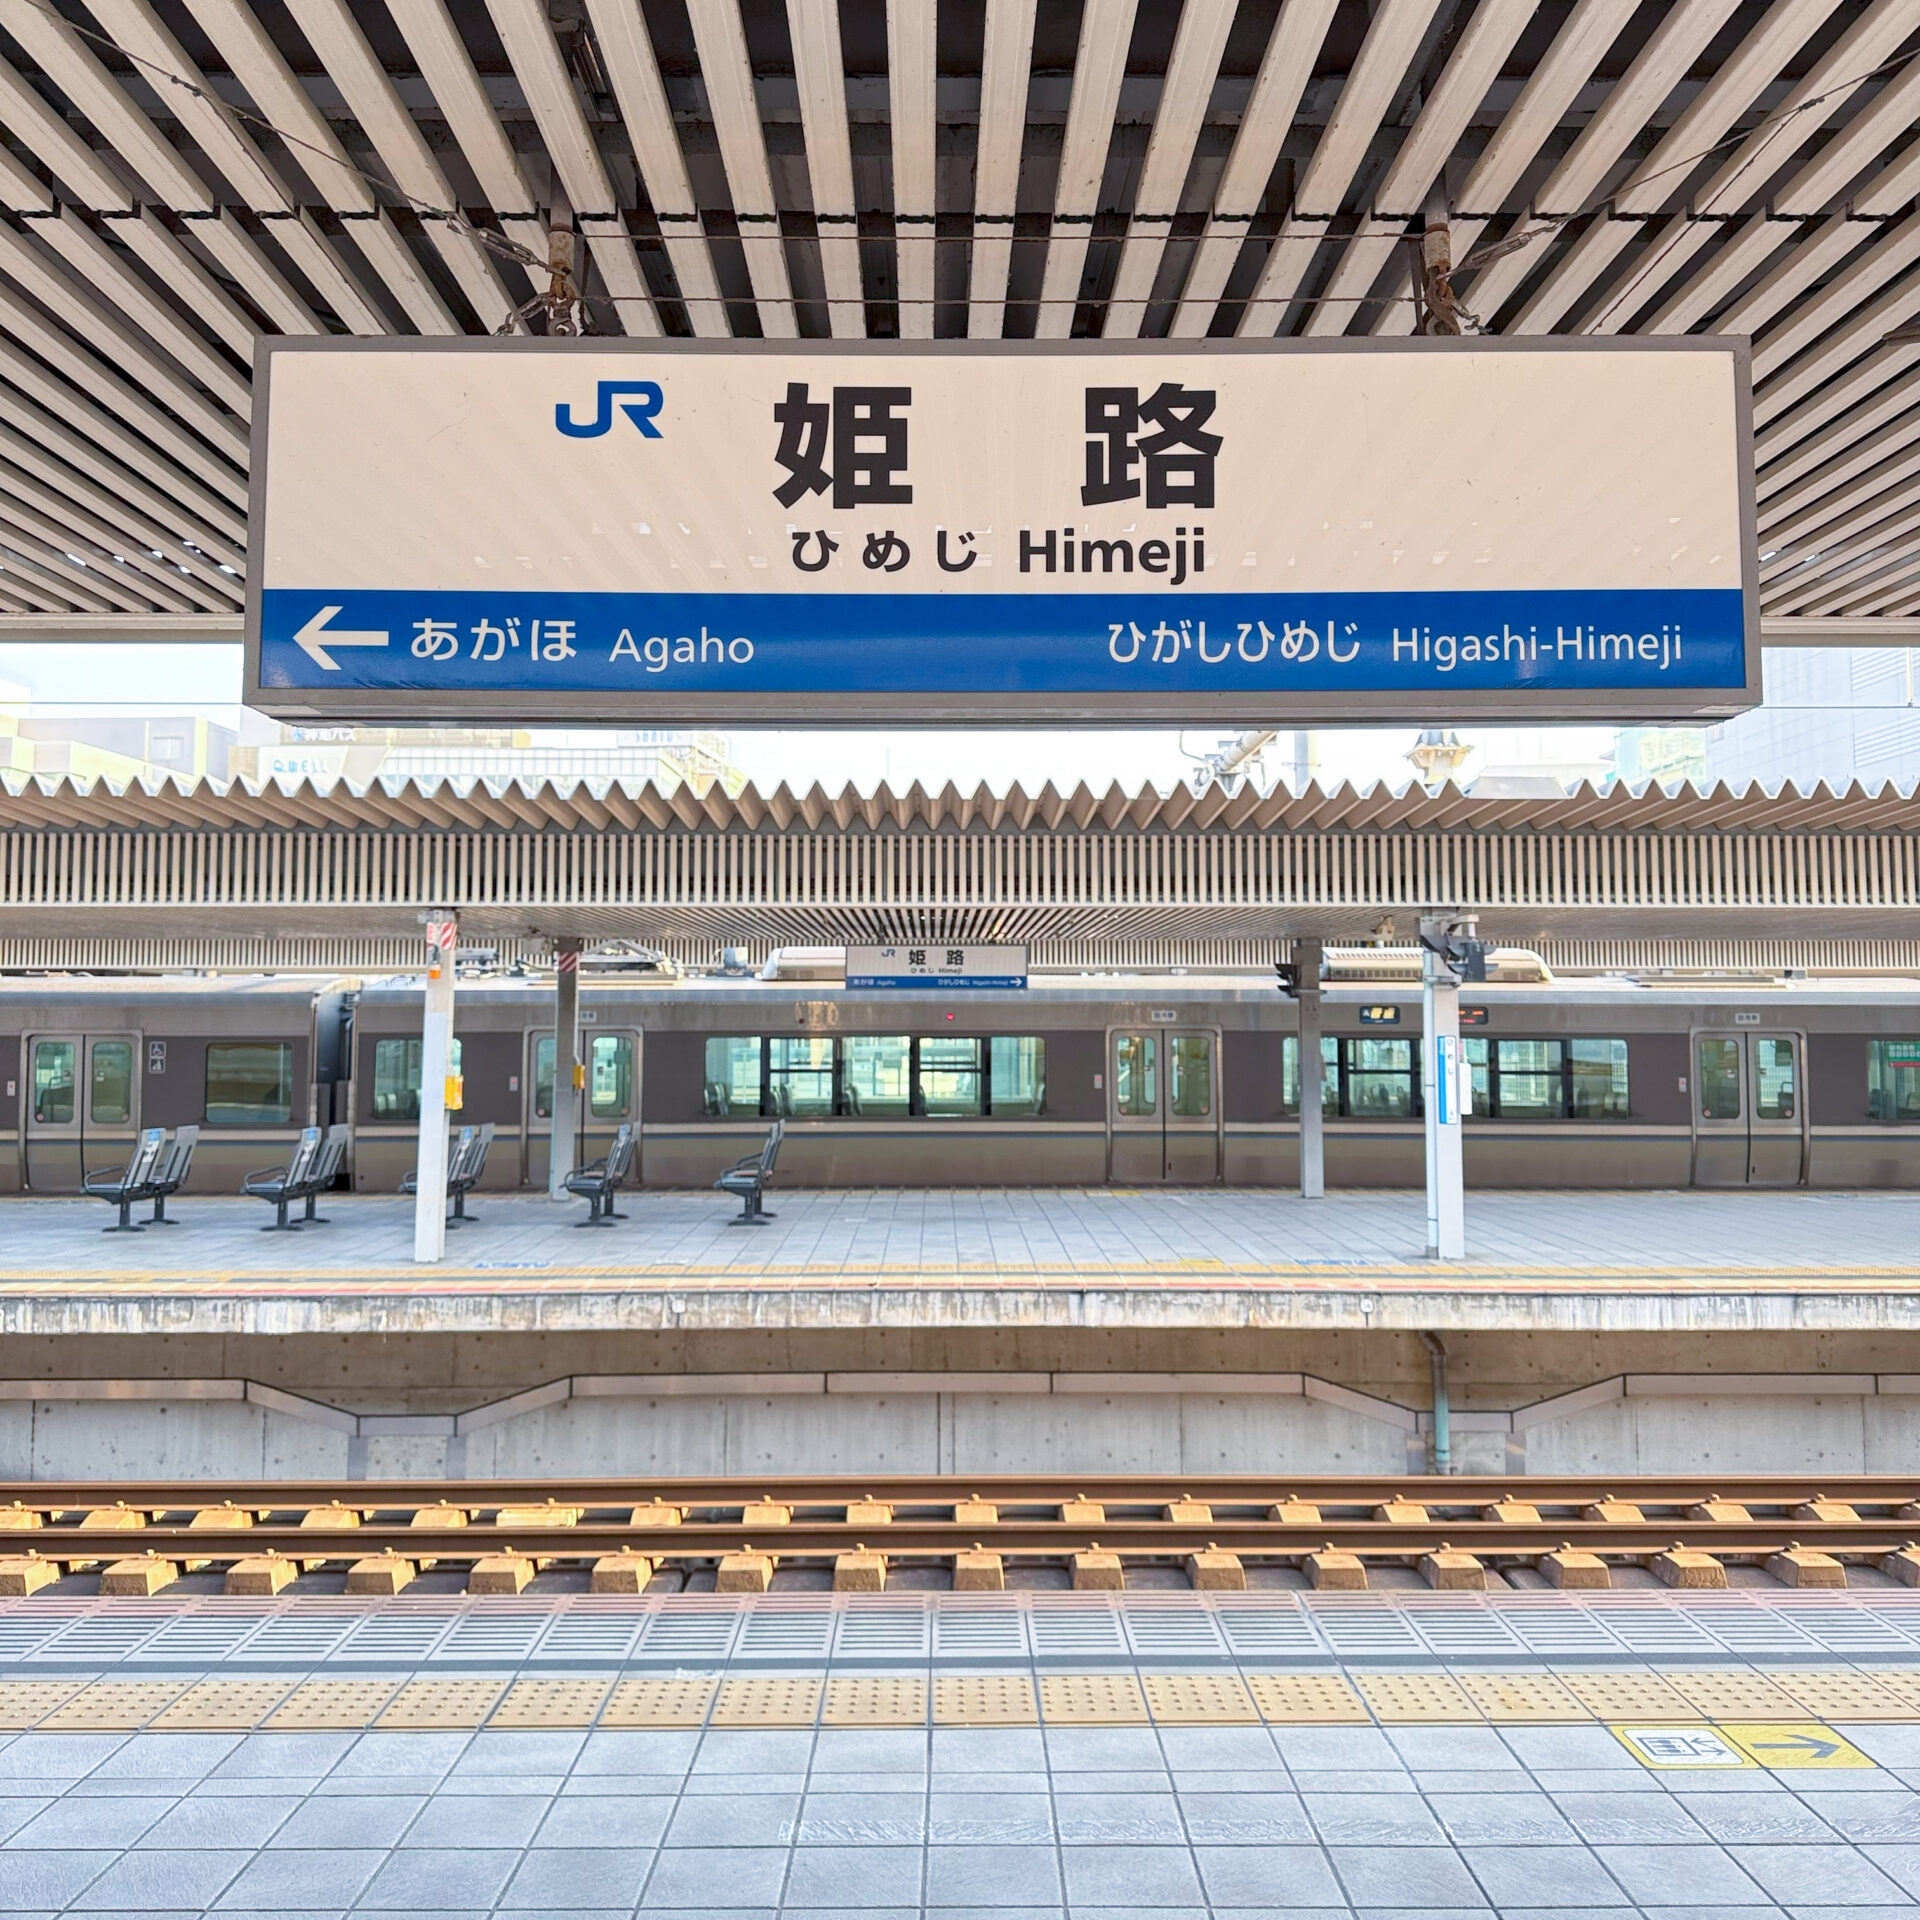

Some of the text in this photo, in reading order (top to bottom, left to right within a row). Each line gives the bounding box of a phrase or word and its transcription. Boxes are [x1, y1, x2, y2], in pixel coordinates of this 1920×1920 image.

[556, 381, 663, 437] JR
[773, 383, 1223, 509] 姫路
[792, 528, 1205, 585] ひめじ Himeji
[412, 618, 754, 673] あがほ Agaho
[1108, 620, 1682, 672] ひがしひめじ Higashi-Himeji
[881, 949, 896, 958] JR
[908, 949, 965, 966] 姫路
[938, 967, 963, 975] Himeji
